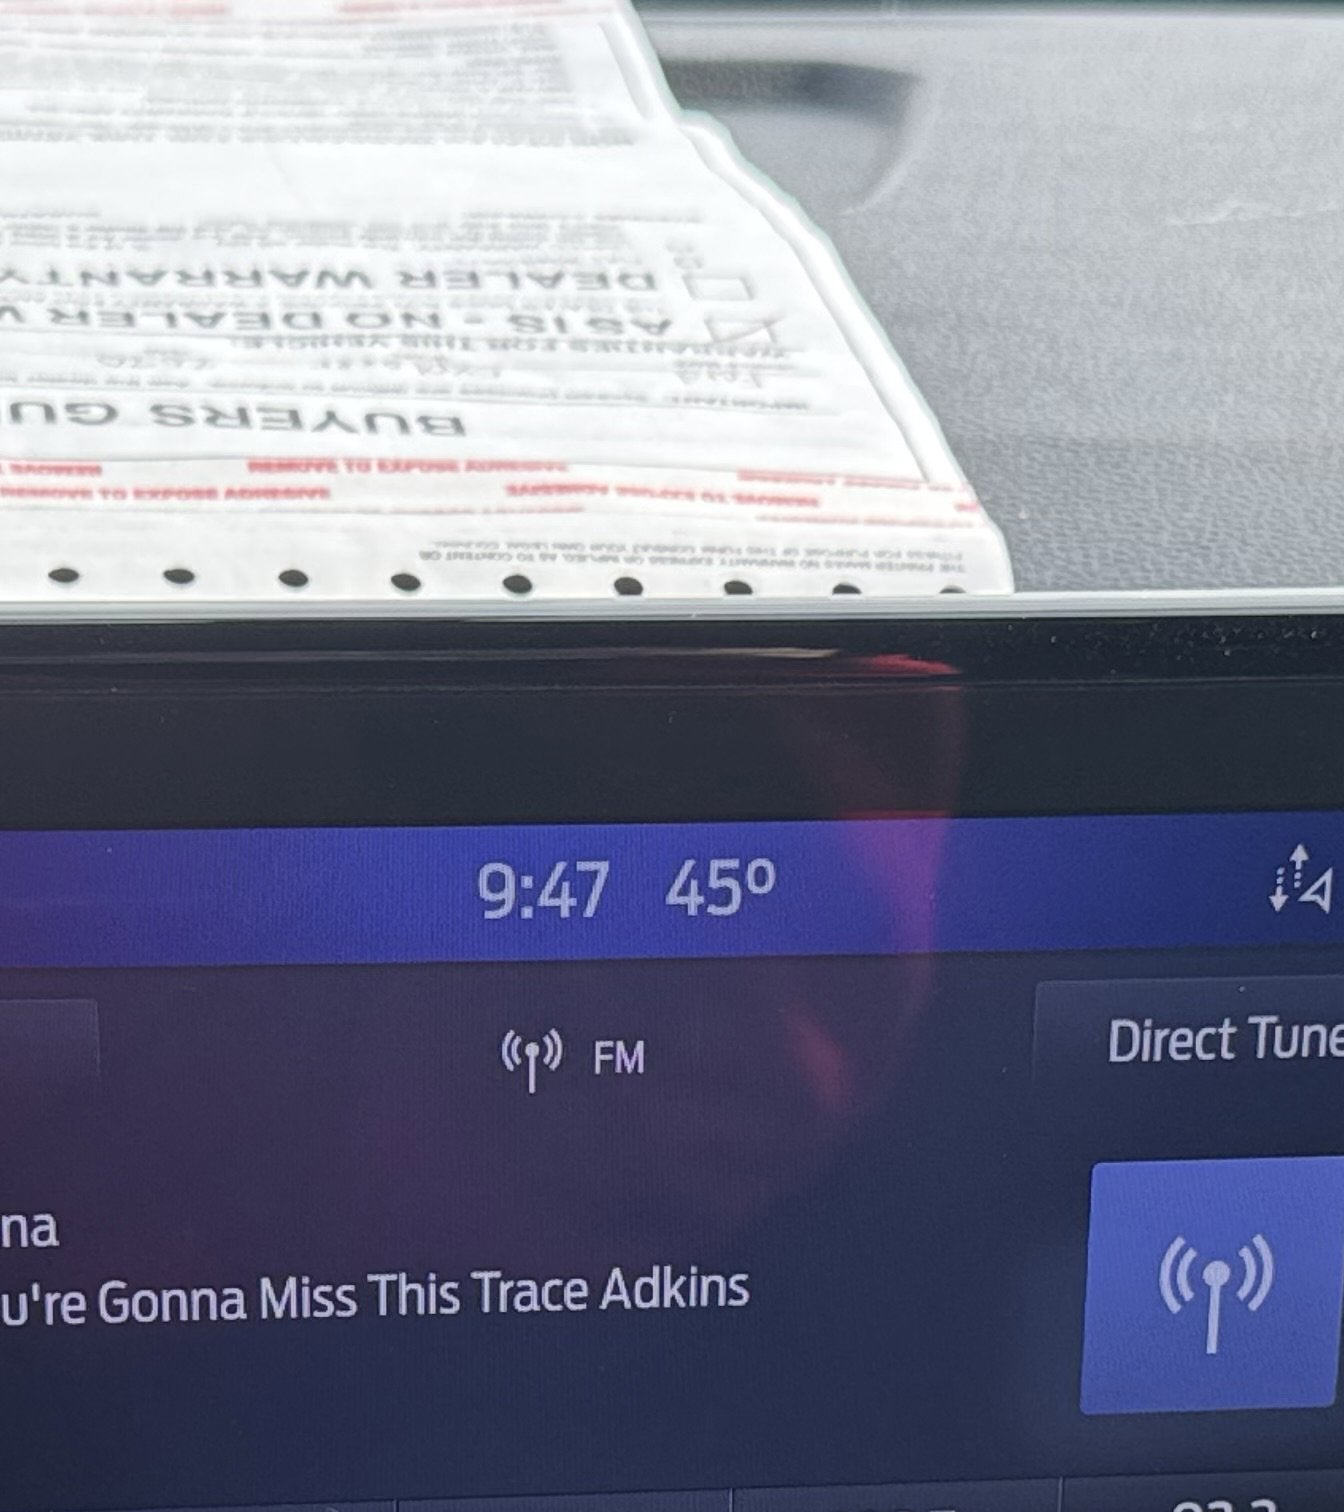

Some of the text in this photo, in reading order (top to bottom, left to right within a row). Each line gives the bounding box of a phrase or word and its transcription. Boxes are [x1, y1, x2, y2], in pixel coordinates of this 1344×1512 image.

[395, 270, 656, 290] DEALER
[46, 309, 321, 330] DEALER
[345, 312, 442, 329] NO
[507, 315, 568, 334] IS
[586, 317, 672, 336] AS
[149, 403, 466, 437] BUYERS
[478, 860, 610, 920] 9:47
[1109, 1017, 1238, 1063] Direct
[594, 1040, 645, 1075] FM
[98, 1279, 248, 1324] Gonna
[260, 1276, 358, 1319] Miss
[366, 1272, 461, 1316] This
[470, 1270, 589, 1313] Trace
[599, 1265, 750, 1310] Adkins
